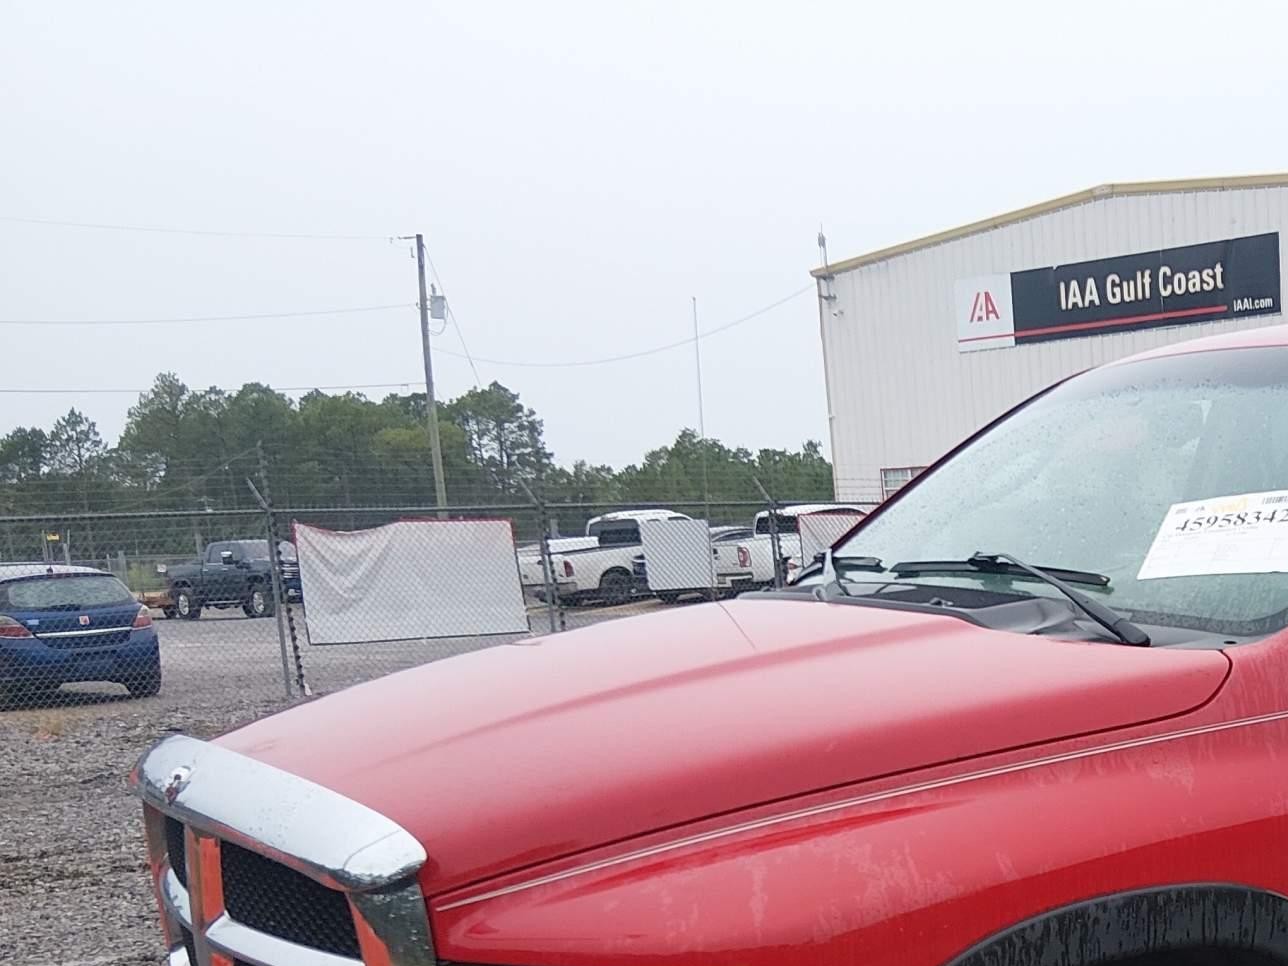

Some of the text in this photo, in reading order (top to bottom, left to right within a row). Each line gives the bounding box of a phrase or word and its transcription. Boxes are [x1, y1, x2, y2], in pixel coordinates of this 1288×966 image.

[1059, 261, 1224, 310] IAA Gulf Coast
